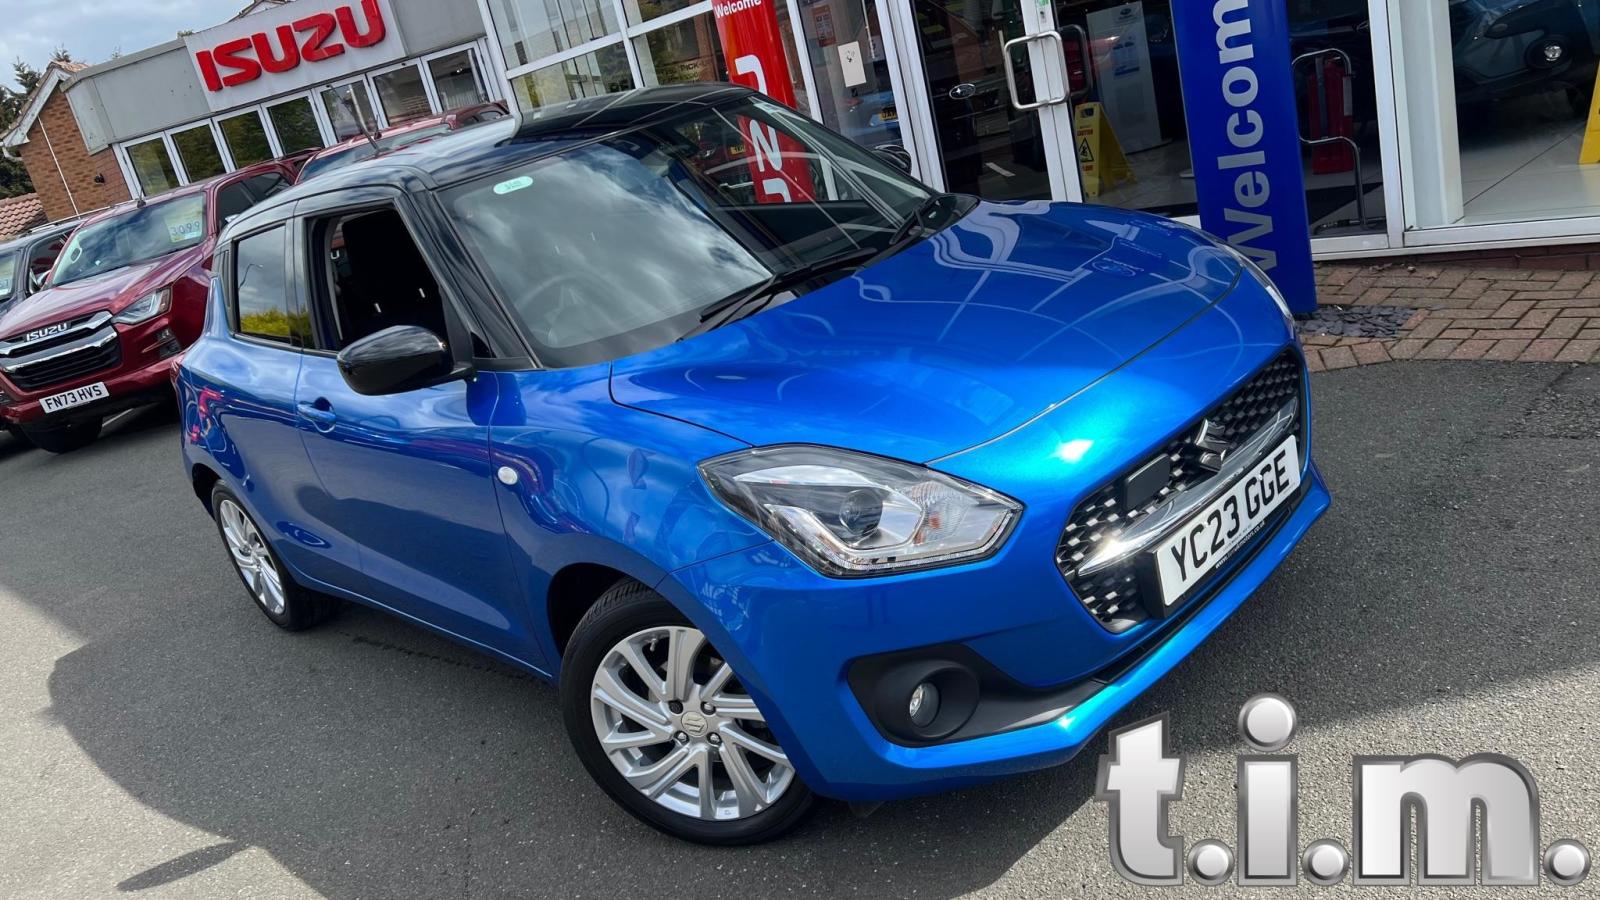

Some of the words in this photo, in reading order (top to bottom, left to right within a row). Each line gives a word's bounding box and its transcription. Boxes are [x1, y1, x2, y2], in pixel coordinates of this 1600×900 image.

[196, 0, 386, 92] ISUZU
[26, 322, 68, 342] ISUZU
[44, 392, 77, 410] FN73
[77, 385, 102, 401] HVS
[1171, 494, 1240, 582] YC23
[1244, 449, 1290, 520] GGE
